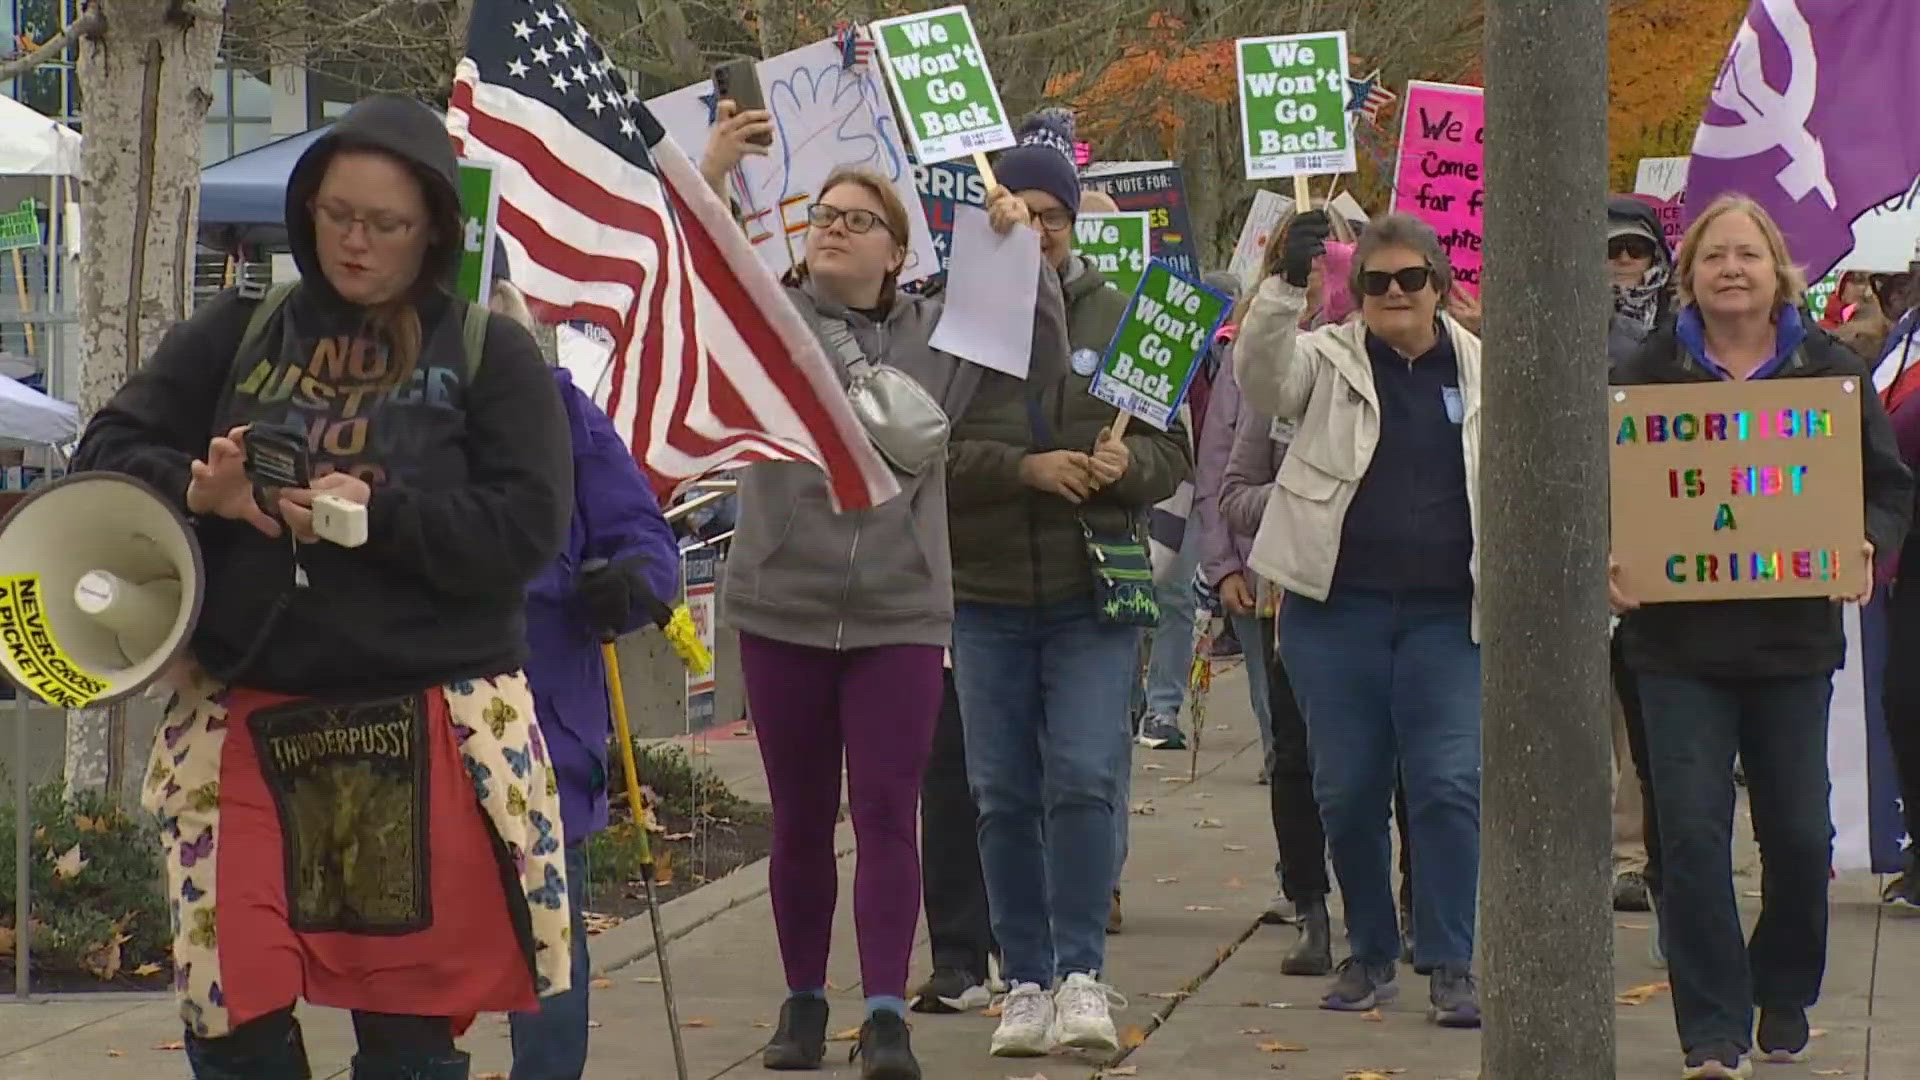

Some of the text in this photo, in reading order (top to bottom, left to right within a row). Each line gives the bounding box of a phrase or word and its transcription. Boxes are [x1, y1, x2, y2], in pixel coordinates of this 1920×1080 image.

[901, 20, 948, 48] We
[891, 44, 979, 80] Won't
[1266, 41, 1316, 68] We
[926, 78, 967, 105] Go
[1246, 67, 1341, 98] Won't
[919, 101, 995, 137] Back
[1275, 98, 1318, 124] Go
[1419, 107, 1463, 142] We
[1258, 125, 1338, 154] Back
[1421, 151, 1479, 180] Come
[914, 167, 987, 204] RRIS
[1116, 177, 1147, 193] VOTE
[1147, 174, 1172, 189] FOR:
[1415, 183, 1455, 212] far
[1075, 221, 1119, 244] We
[1073, 247, 1142, 273] n't
[1166, 275, 1201, 315] We
[1135, 294, 1205, 351] Won't
[309, 336, 389, 381] NO
[1138, 333, 1172, 367] Go
[1111, 352, 1174, 403] Back
[1616, 408, 1833, 445] ABORTION
[1668, 465, 1808, 498] IS NOT
[1713, 503, 1737, 531] A
[1665, 549, 1840, 583] CRIME!!
[20, 579, 56, 658] NEVER
[0, 605, 44, 680] PICKET
[269, 708, 411, 771] THUNDERPUSSY
